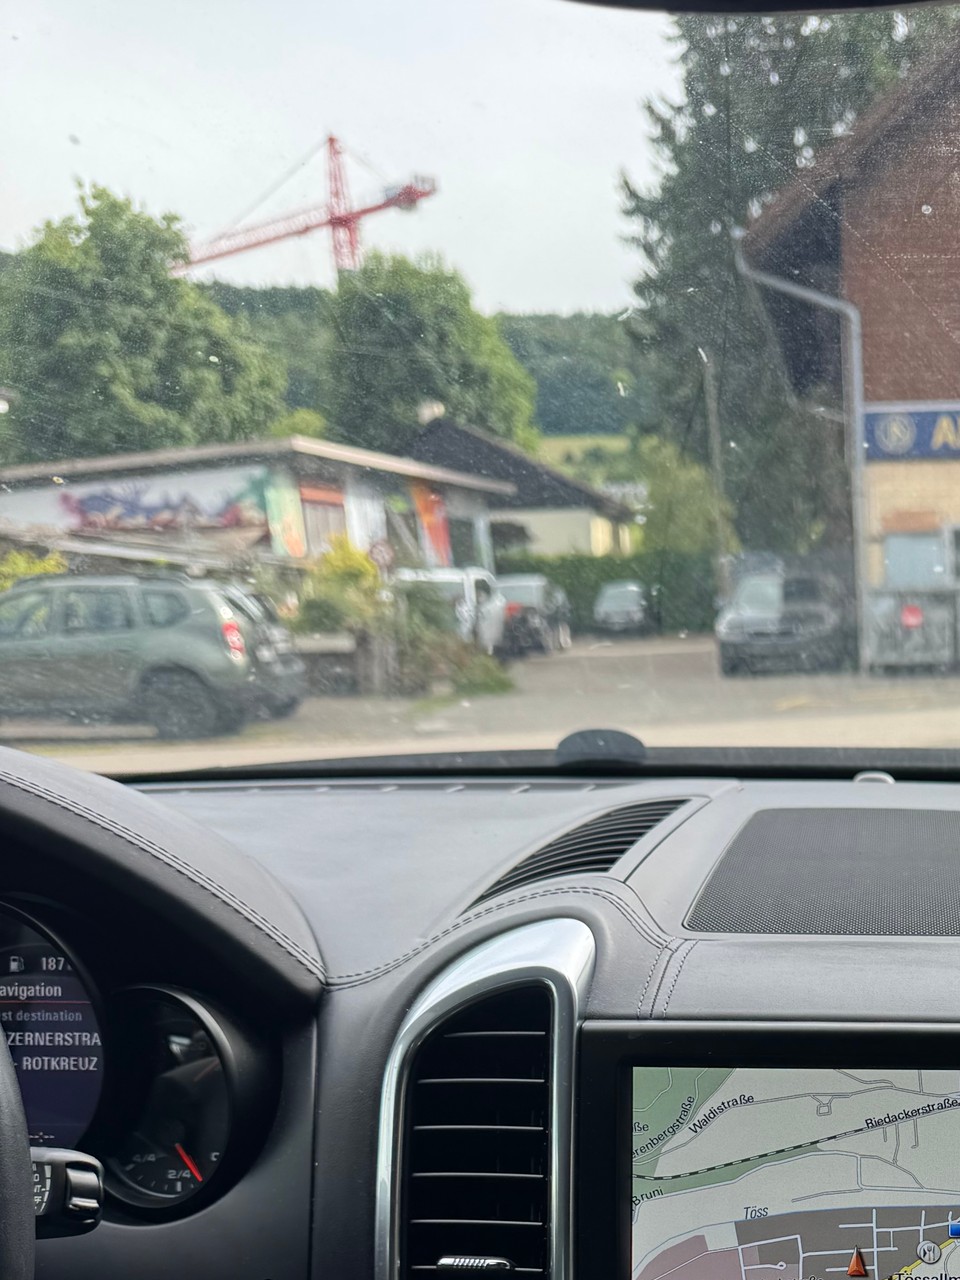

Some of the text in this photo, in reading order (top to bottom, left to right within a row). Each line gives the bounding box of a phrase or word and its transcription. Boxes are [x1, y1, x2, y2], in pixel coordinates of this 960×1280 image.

[41, 957, 65, 970] 187
[16, 1009, 82, 1021] destination
[22, 1057, 98, 1071] ROTKREUZ
[688, 1094, 755, 1134] Waldistraße
[864, 1098, 959, 1129] Riedackerstraße
[743, 1205, 769, 1220] Töss
